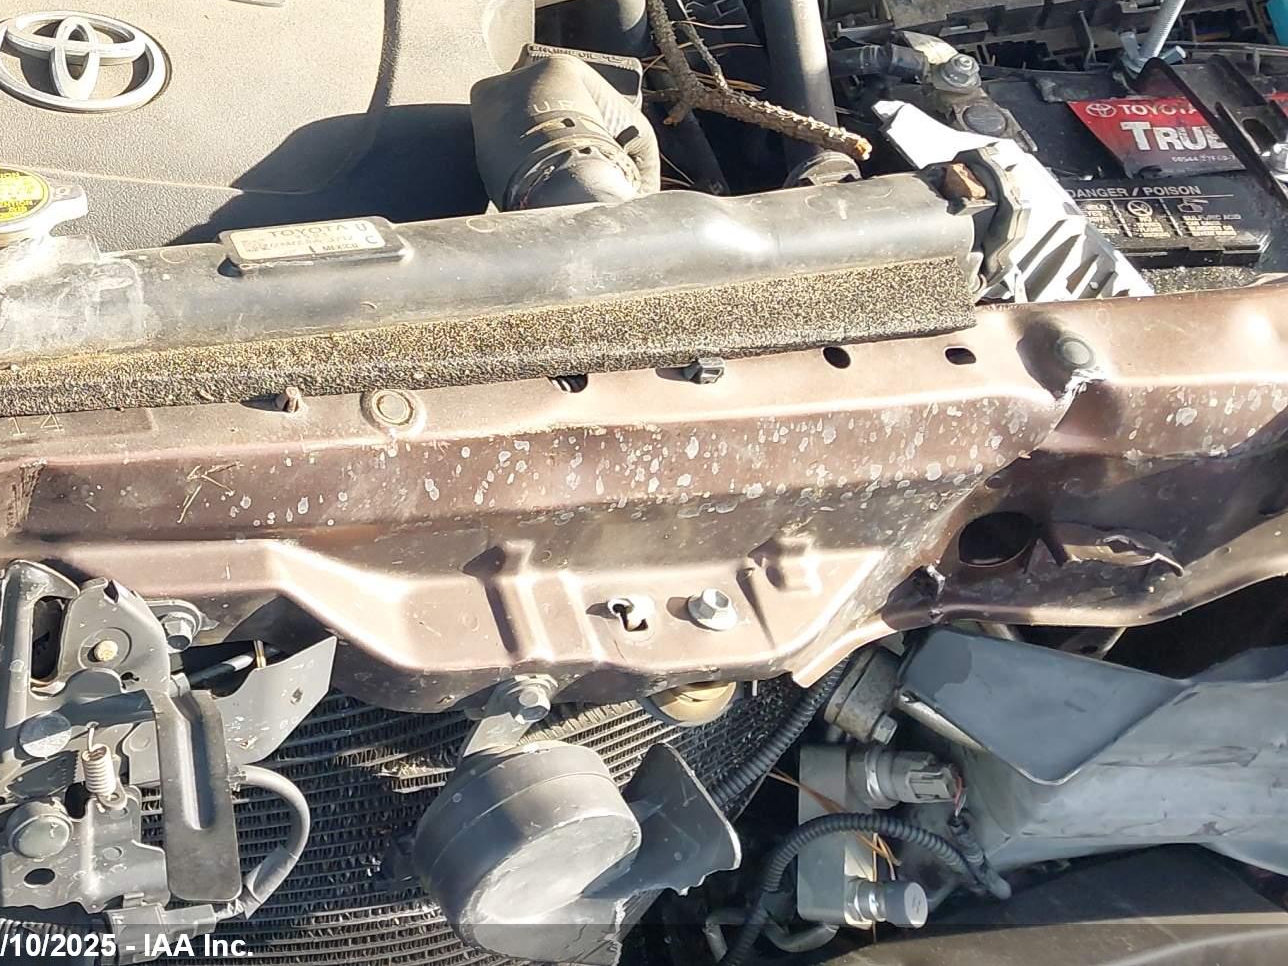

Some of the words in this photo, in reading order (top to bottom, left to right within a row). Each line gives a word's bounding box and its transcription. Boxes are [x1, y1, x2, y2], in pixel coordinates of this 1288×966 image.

[1068, 187, 1128, 198] DANGER
[1142, 185, 1202, 196] POISON
[268, 224, 349, 238] TOYOTA
